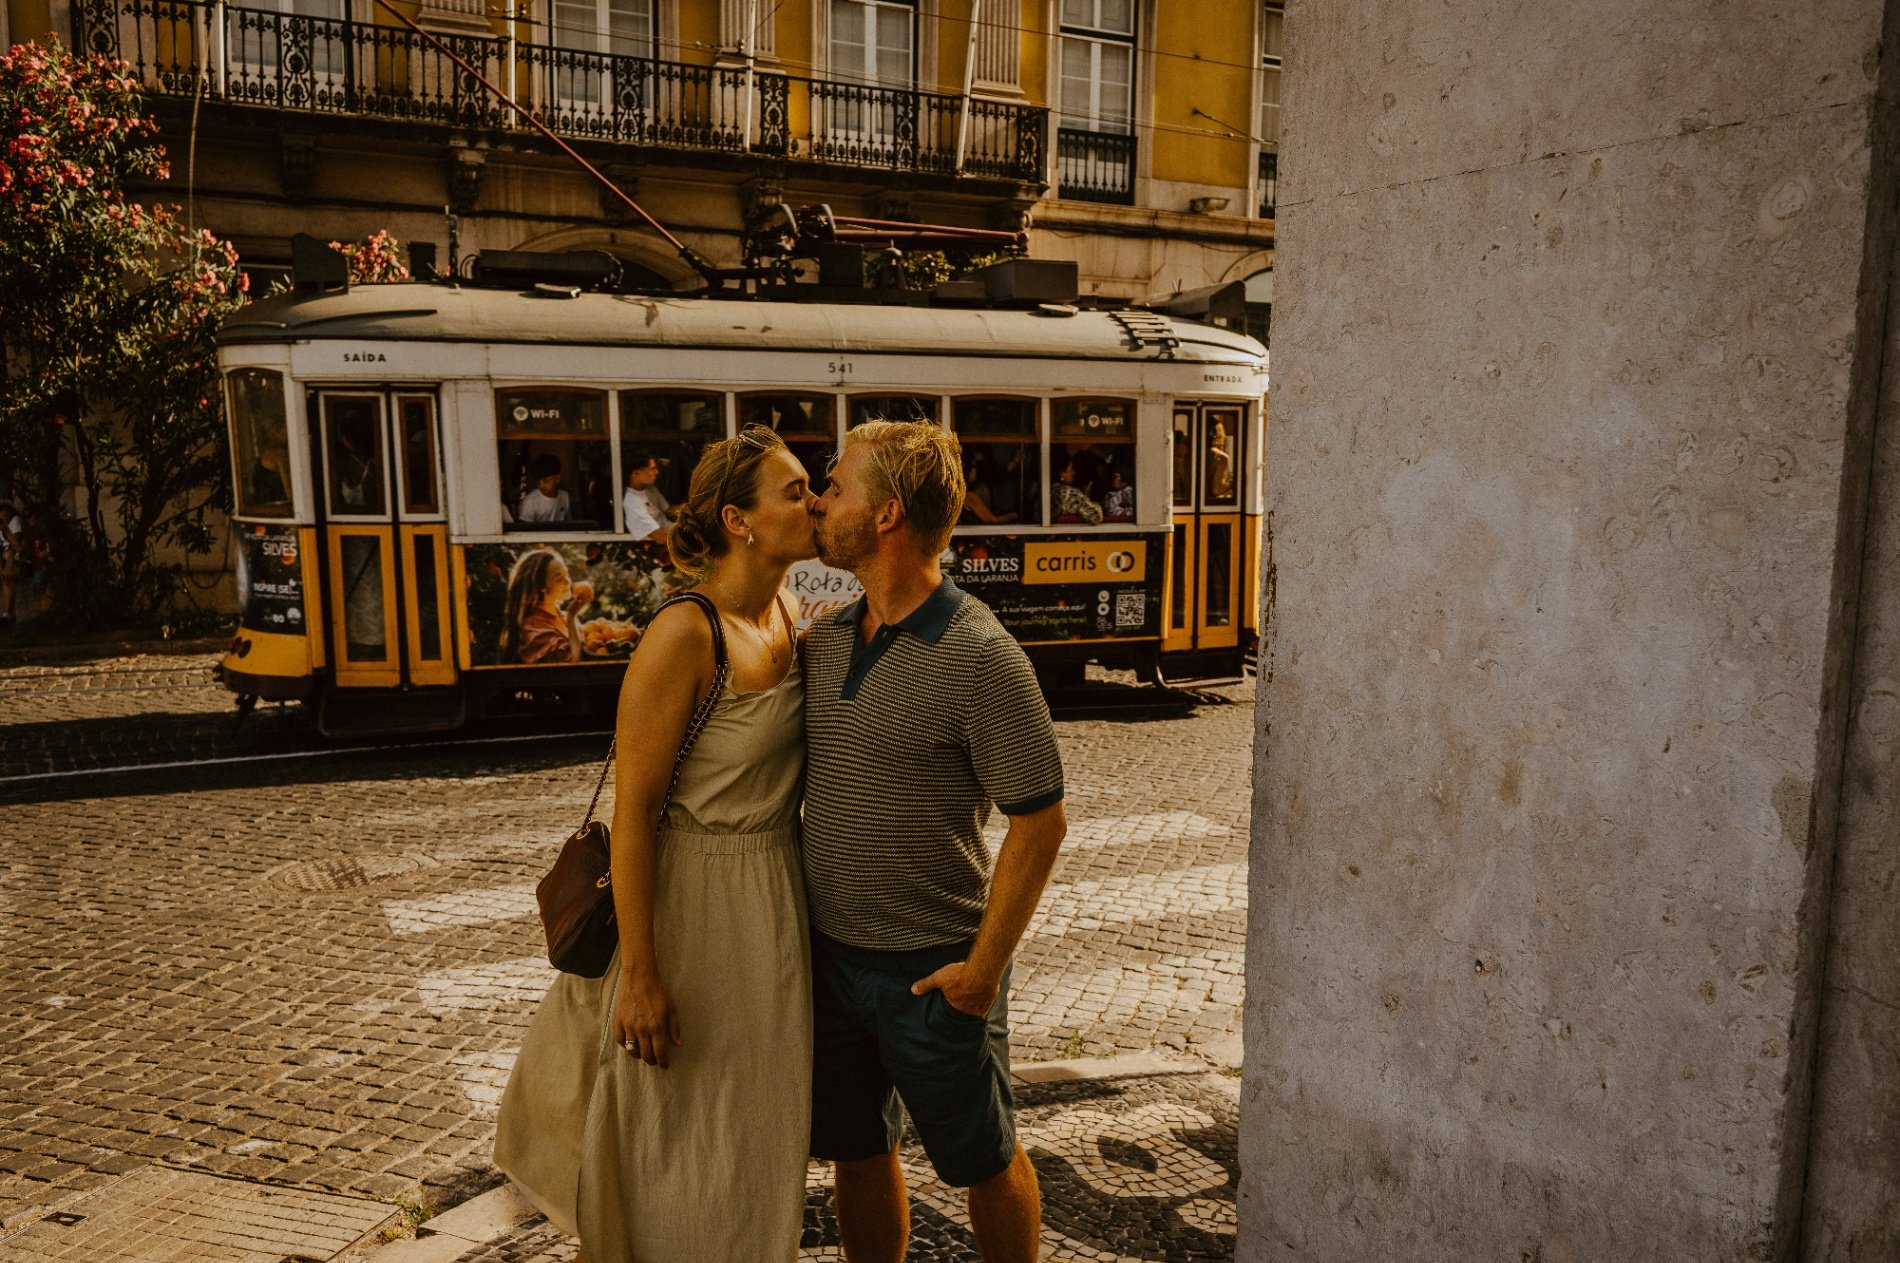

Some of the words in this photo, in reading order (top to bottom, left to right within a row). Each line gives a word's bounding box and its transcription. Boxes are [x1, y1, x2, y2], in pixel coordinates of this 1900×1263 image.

[344, 352, 387, 362] SAÍDA
[828, 362, 853, 374] 541
[1203, 374, 1243, 384] ENTRADA
[530, 408, 560, 419] WI-FI
[1101, 417, 1124, 426] WI-FI
[262, 542, 298, 557] SILVES
[962, 557, 1020, 573] SILVES
[1036, 551, 1097, 572] carris
[794, 571, 843, 595] Rota
[966, 575, 980, 583] DA
[980, 574, 1020, 583] LARANJA
